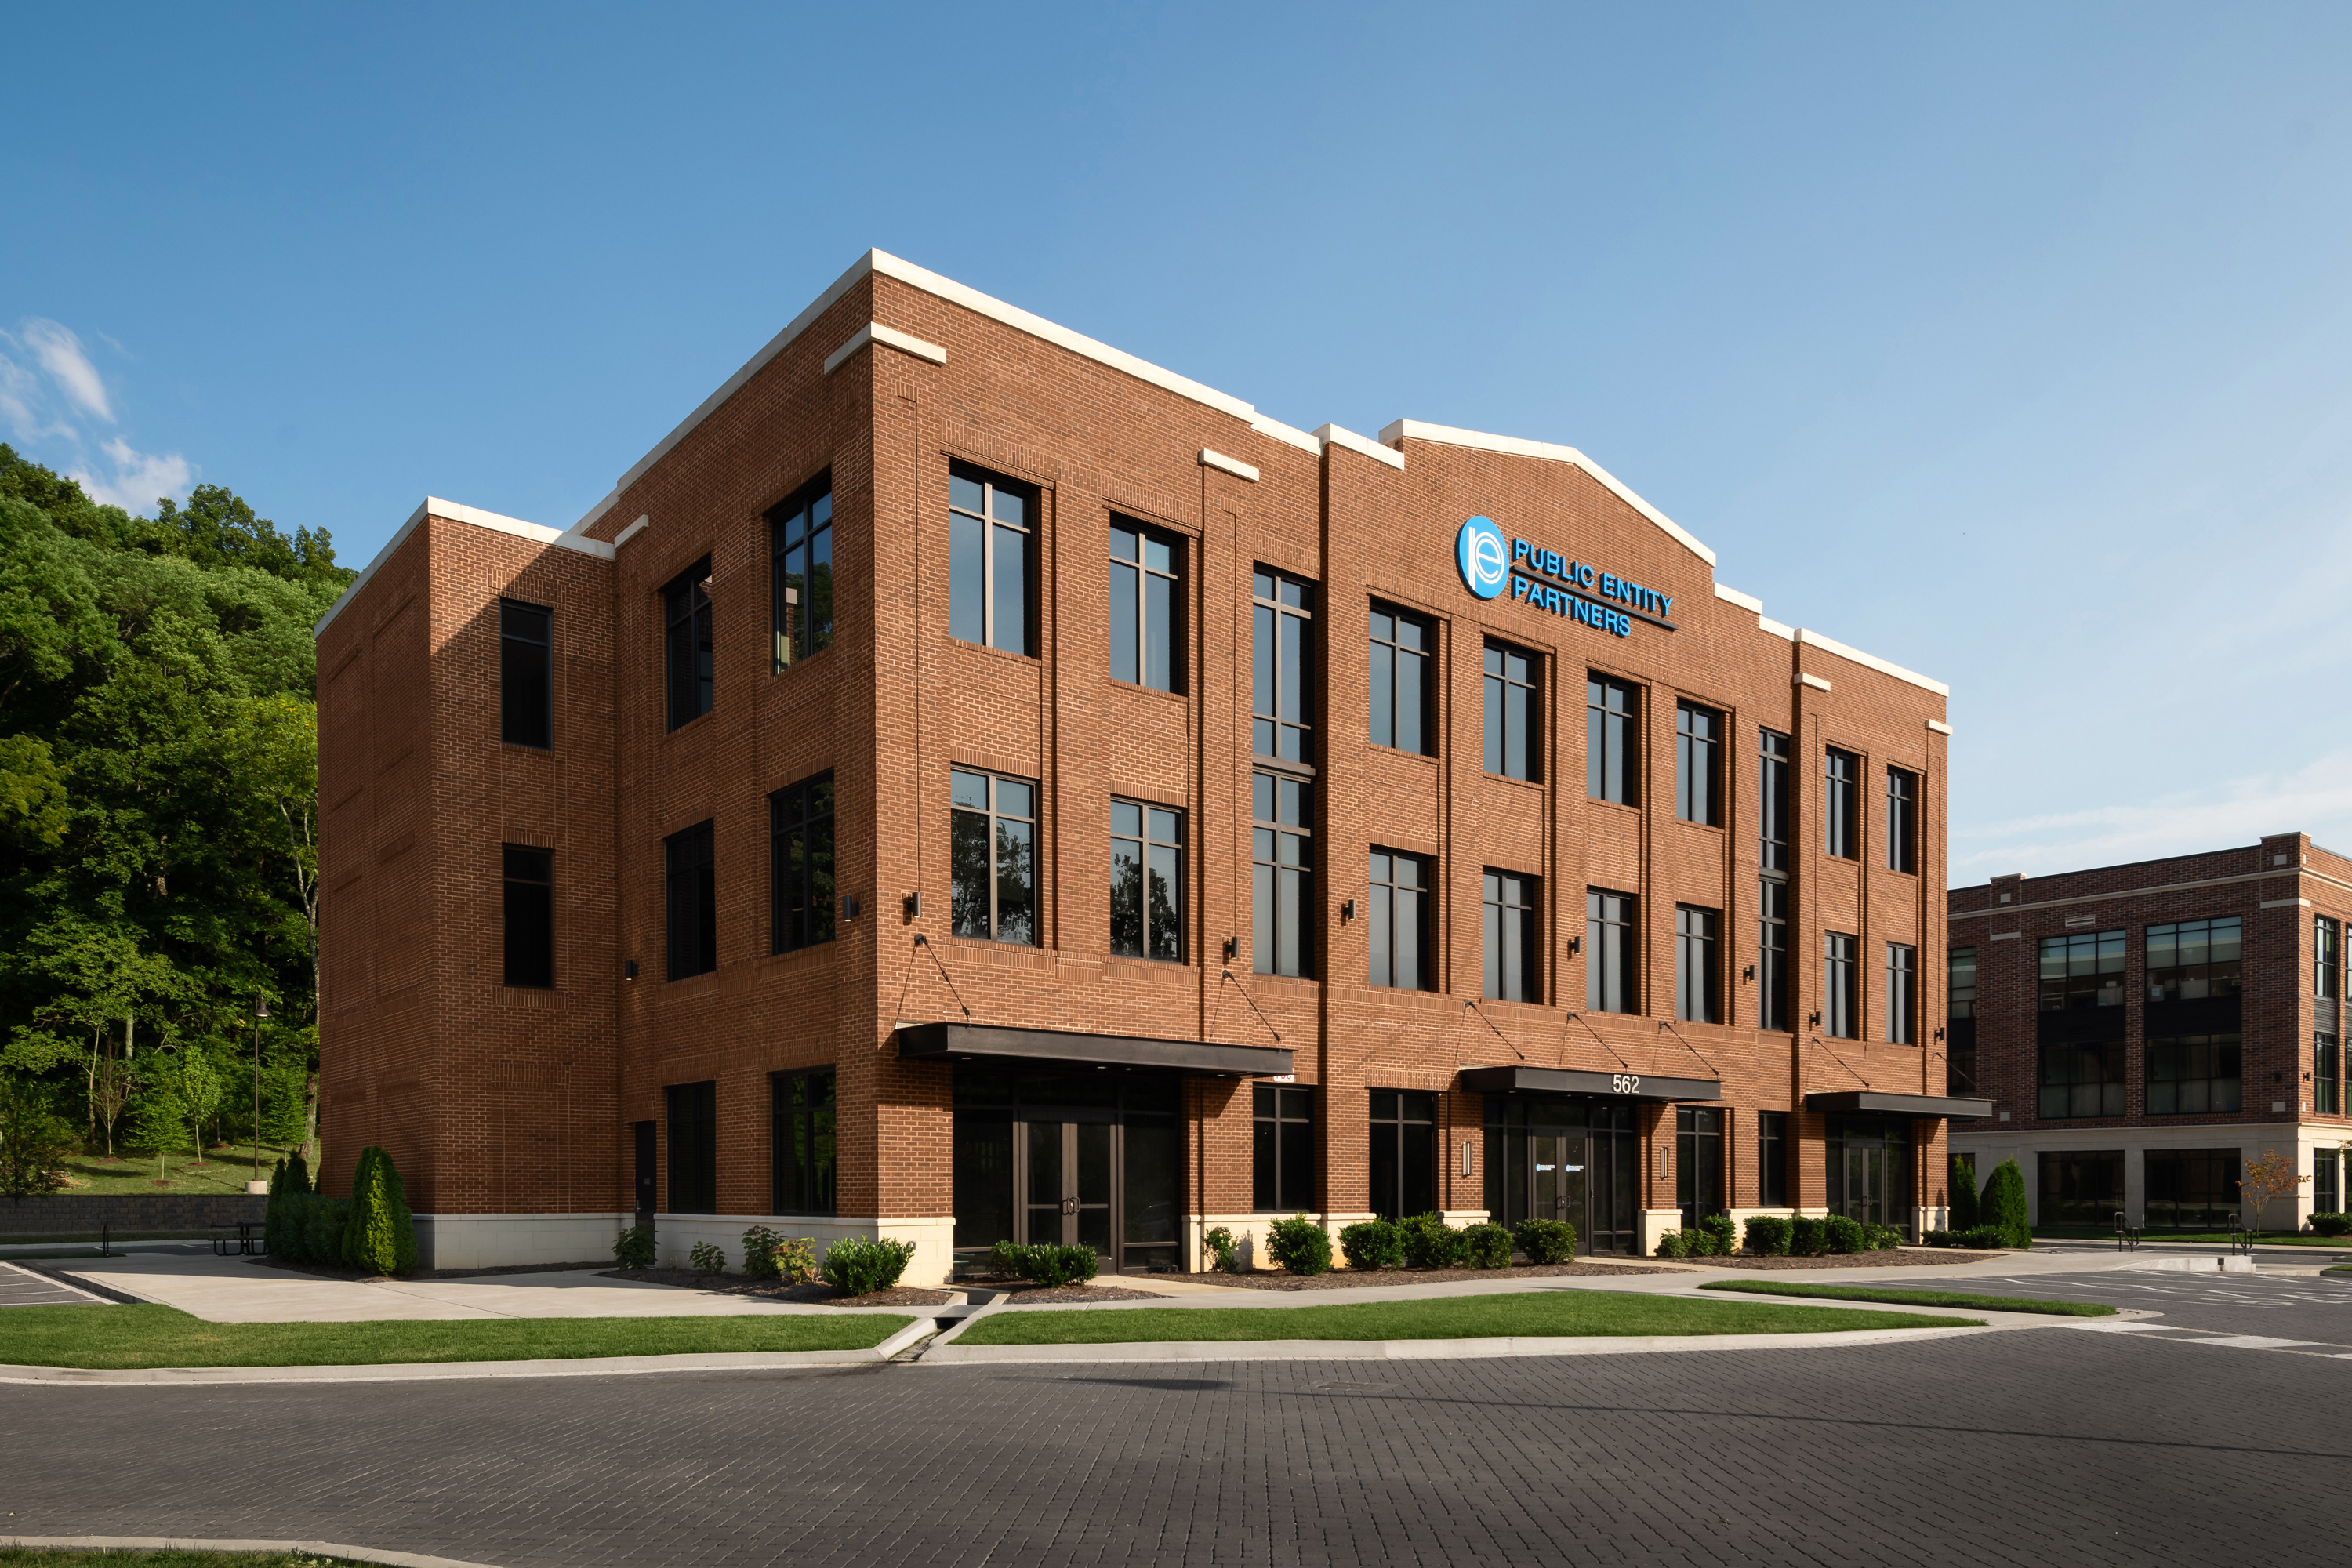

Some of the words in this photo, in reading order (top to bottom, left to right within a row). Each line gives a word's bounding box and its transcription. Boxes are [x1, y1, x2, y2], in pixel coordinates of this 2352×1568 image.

[1512, 538, 1595, 587] PUBLIC
[1600, 572, 1673, 617] ENTITY
[1512, 575, 1631, 637] PARTNERS
[1613, 1074, 1640, 1094] 562
